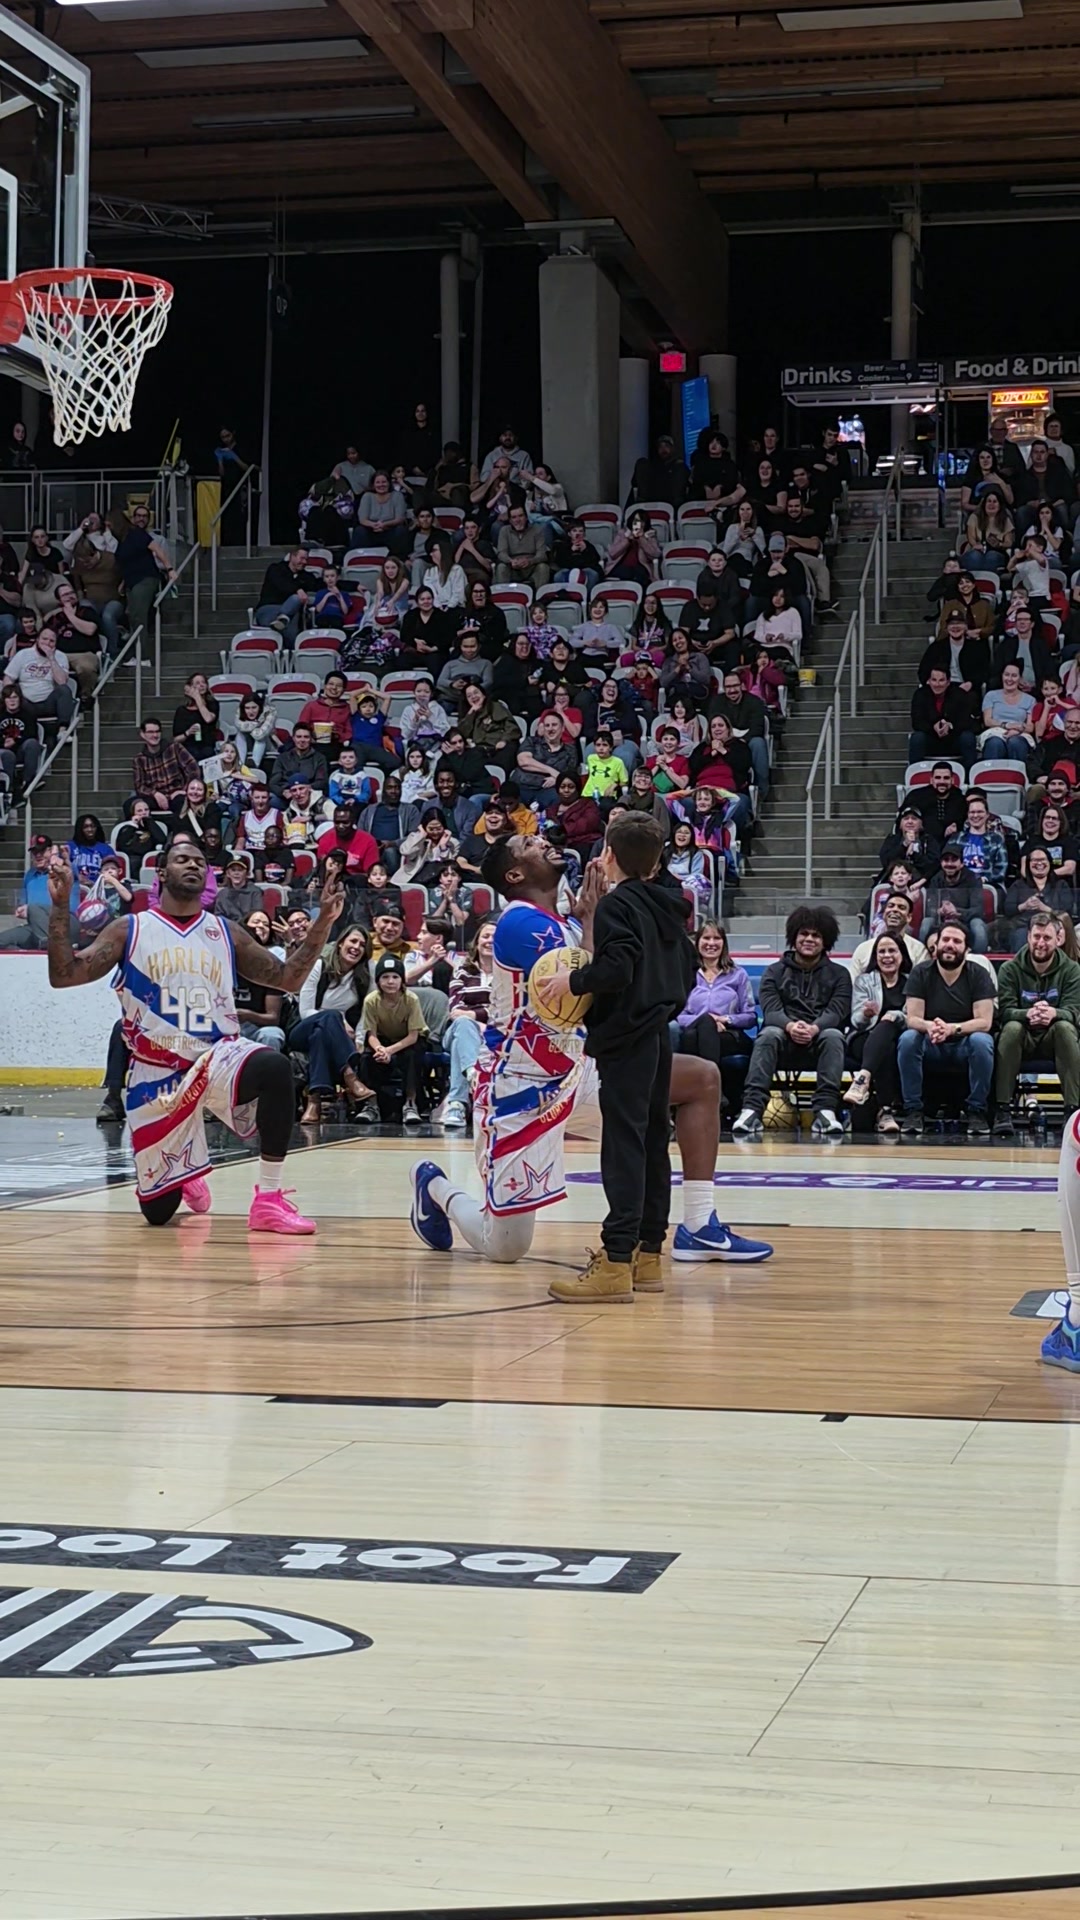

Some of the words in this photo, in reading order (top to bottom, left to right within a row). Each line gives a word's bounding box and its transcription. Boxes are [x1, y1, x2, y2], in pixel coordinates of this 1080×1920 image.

[784, 366, 852, 385] Drinks
[857, 374, 890, 382] Coolers
[955, 358, 1008, 378] Food
[1012, 358, 1029, 376] &
[1033, 356, 1080, 376] Drin
[994, 391, 1047, 402] POPCORN
[147, 948, 223, 989] HARLEM
[160, 985, 213, 1032] 42
[279, 1542, 631, 1584] Foot
